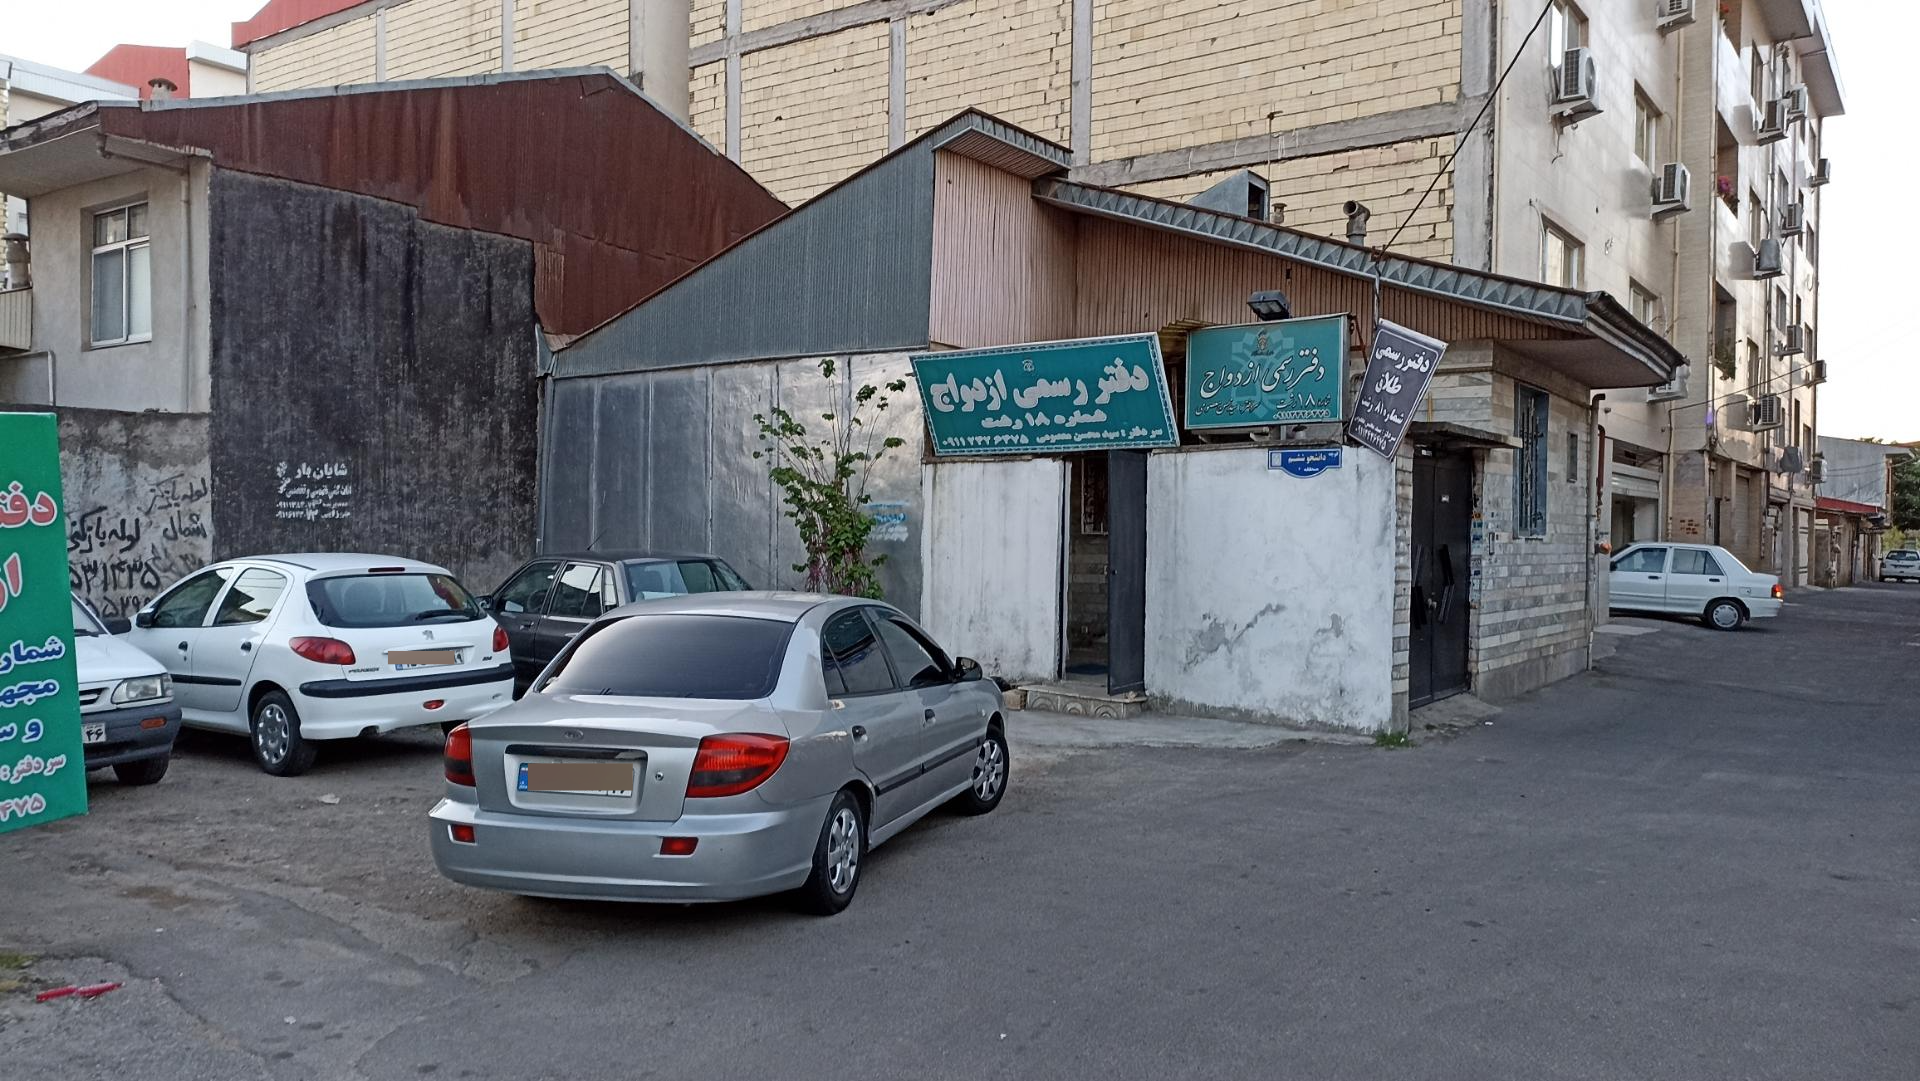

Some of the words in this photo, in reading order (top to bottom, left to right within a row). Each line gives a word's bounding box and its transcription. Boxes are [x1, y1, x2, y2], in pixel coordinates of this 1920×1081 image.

[1287, 348, 1325, 390] دفتر
[1375, 346, 1405, 369] رسمی
[1402, 351, 1430, 373] دفتر
[1095, 357, 1150, 404] دفتر
[1200, 362, 1260, 399] ازدواج
[1261, 356, 1294, 392] رسمی
[1374, 371, 1402, 394] طلاق
[929, 369, 1008, 412] ازدواج
[1013, 376, 1089, 409] رسمی
[1298, 392, 1315, 406] ۱۸
[981, 414, 1024, 430] رشت
[1024, 411, 1051, 427] ۱۸
[1054, 408, 1108, 427] شماره
[181, 477, 208, 501] لوله
[67, 506, 108, 554] بازکنی
[108, 517, 140, 553] لوله
[163, 510, 207, 540] شمال
[0, 636, 65, 674] شمار
